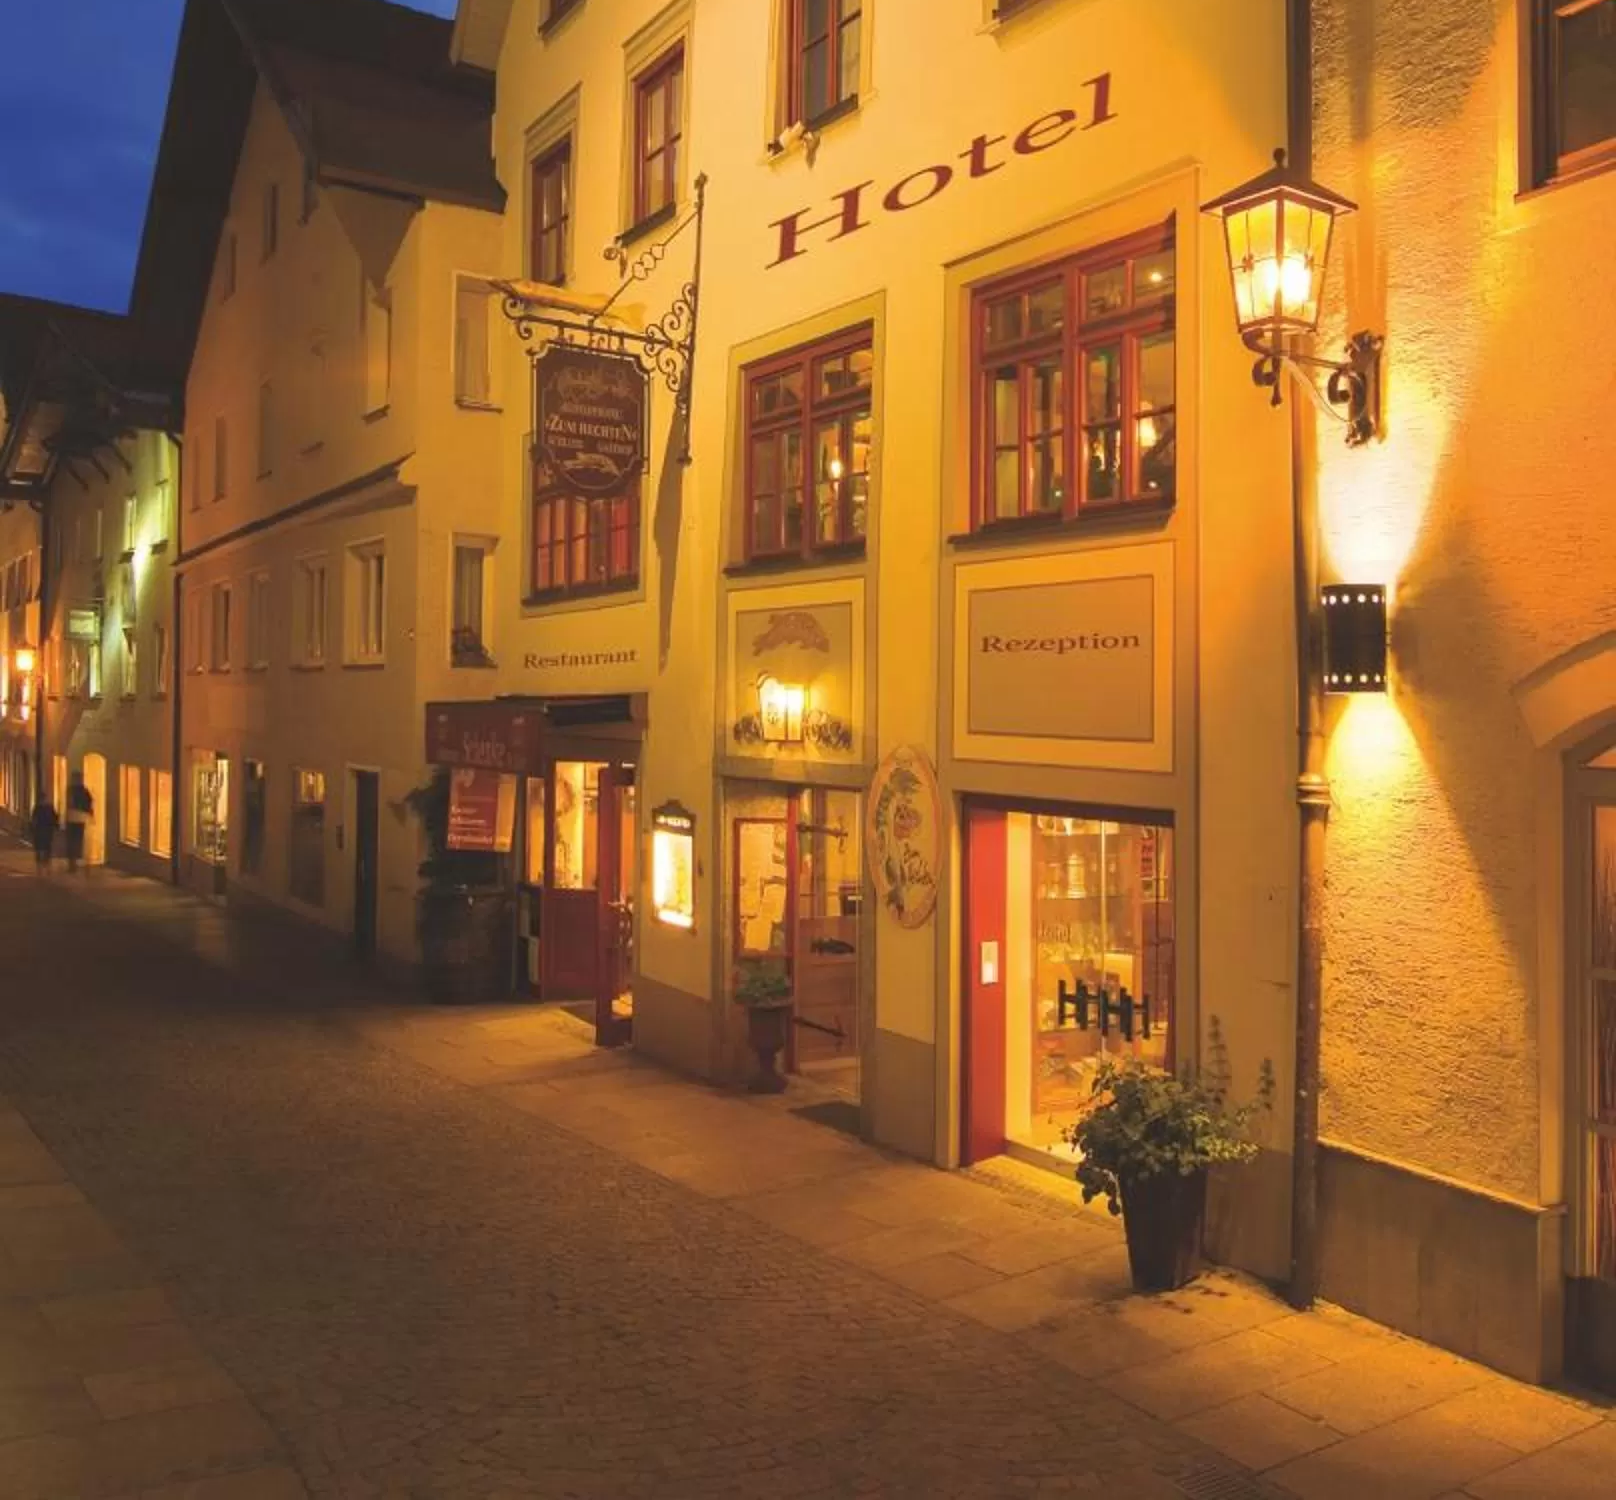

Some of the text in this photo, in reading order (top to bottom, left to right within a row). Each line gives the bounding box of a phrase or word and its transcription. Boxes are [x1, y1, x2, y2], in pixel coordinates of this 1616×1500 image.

[765, 72, 1119, 270] Hotel
[981, 632, 1140, 655] Rezeption
[523, 649, 636, 669] Restaurant
